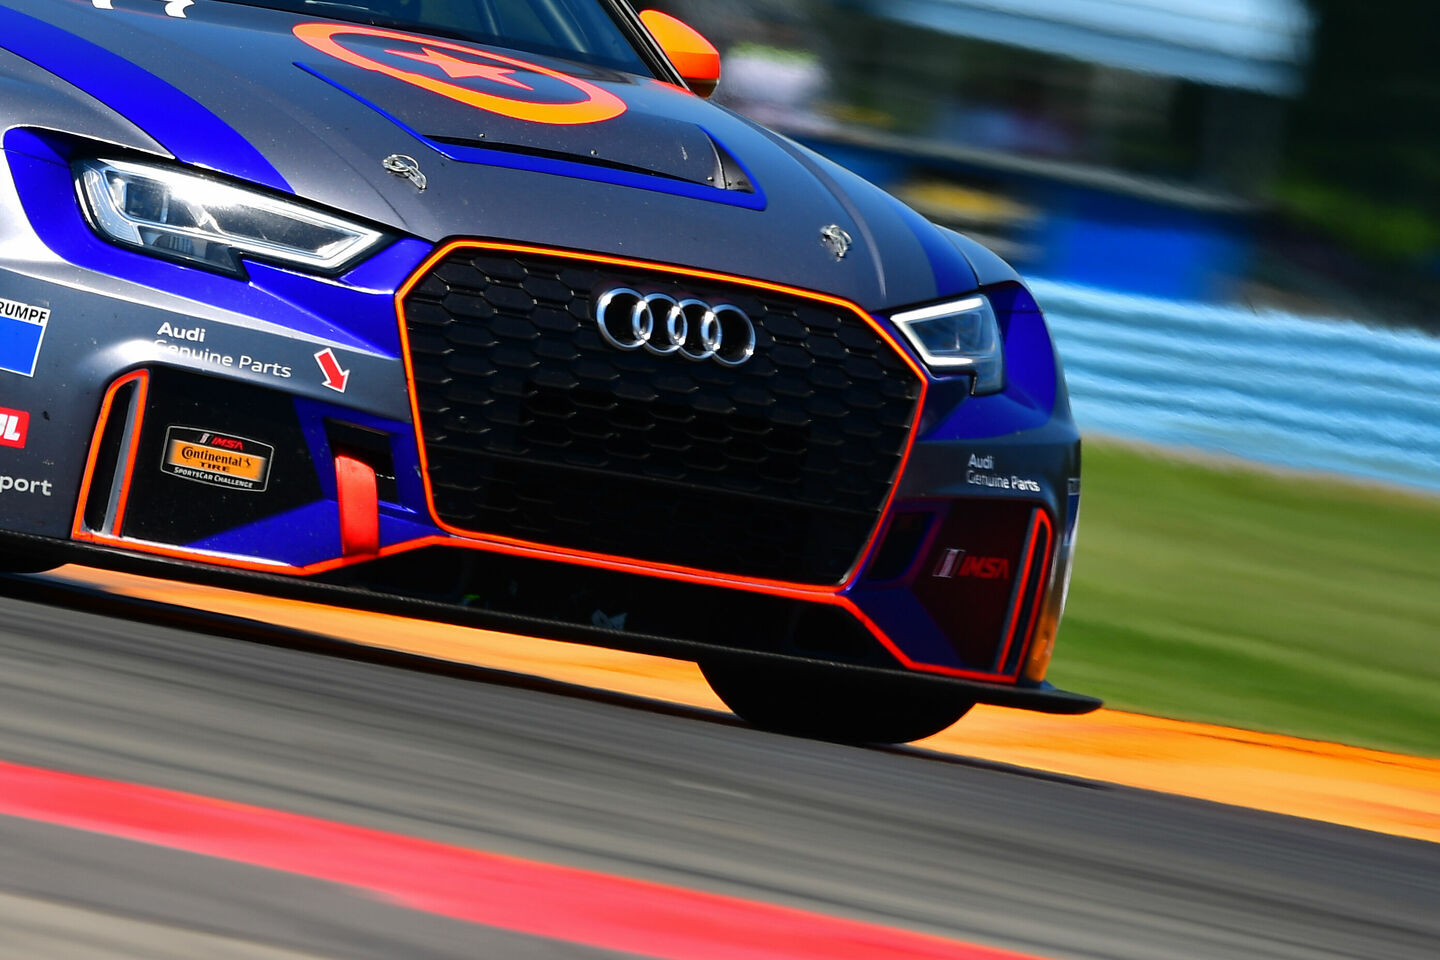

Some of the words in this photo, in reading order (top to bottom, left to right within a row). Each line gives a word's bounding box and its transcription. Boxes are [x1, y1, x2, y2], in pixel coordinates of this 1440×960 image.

[157, 322, 206, 342] Audi
[239, 355, 292, 378] Parts
[181, 446, 242, 468] Continental
[200, 461, 231, 473] TIRE
[968, 453, 993, 469] Audi
[967, 470, 1009, 489] Genuine
[1011, 476, 1041, 492] Parts
